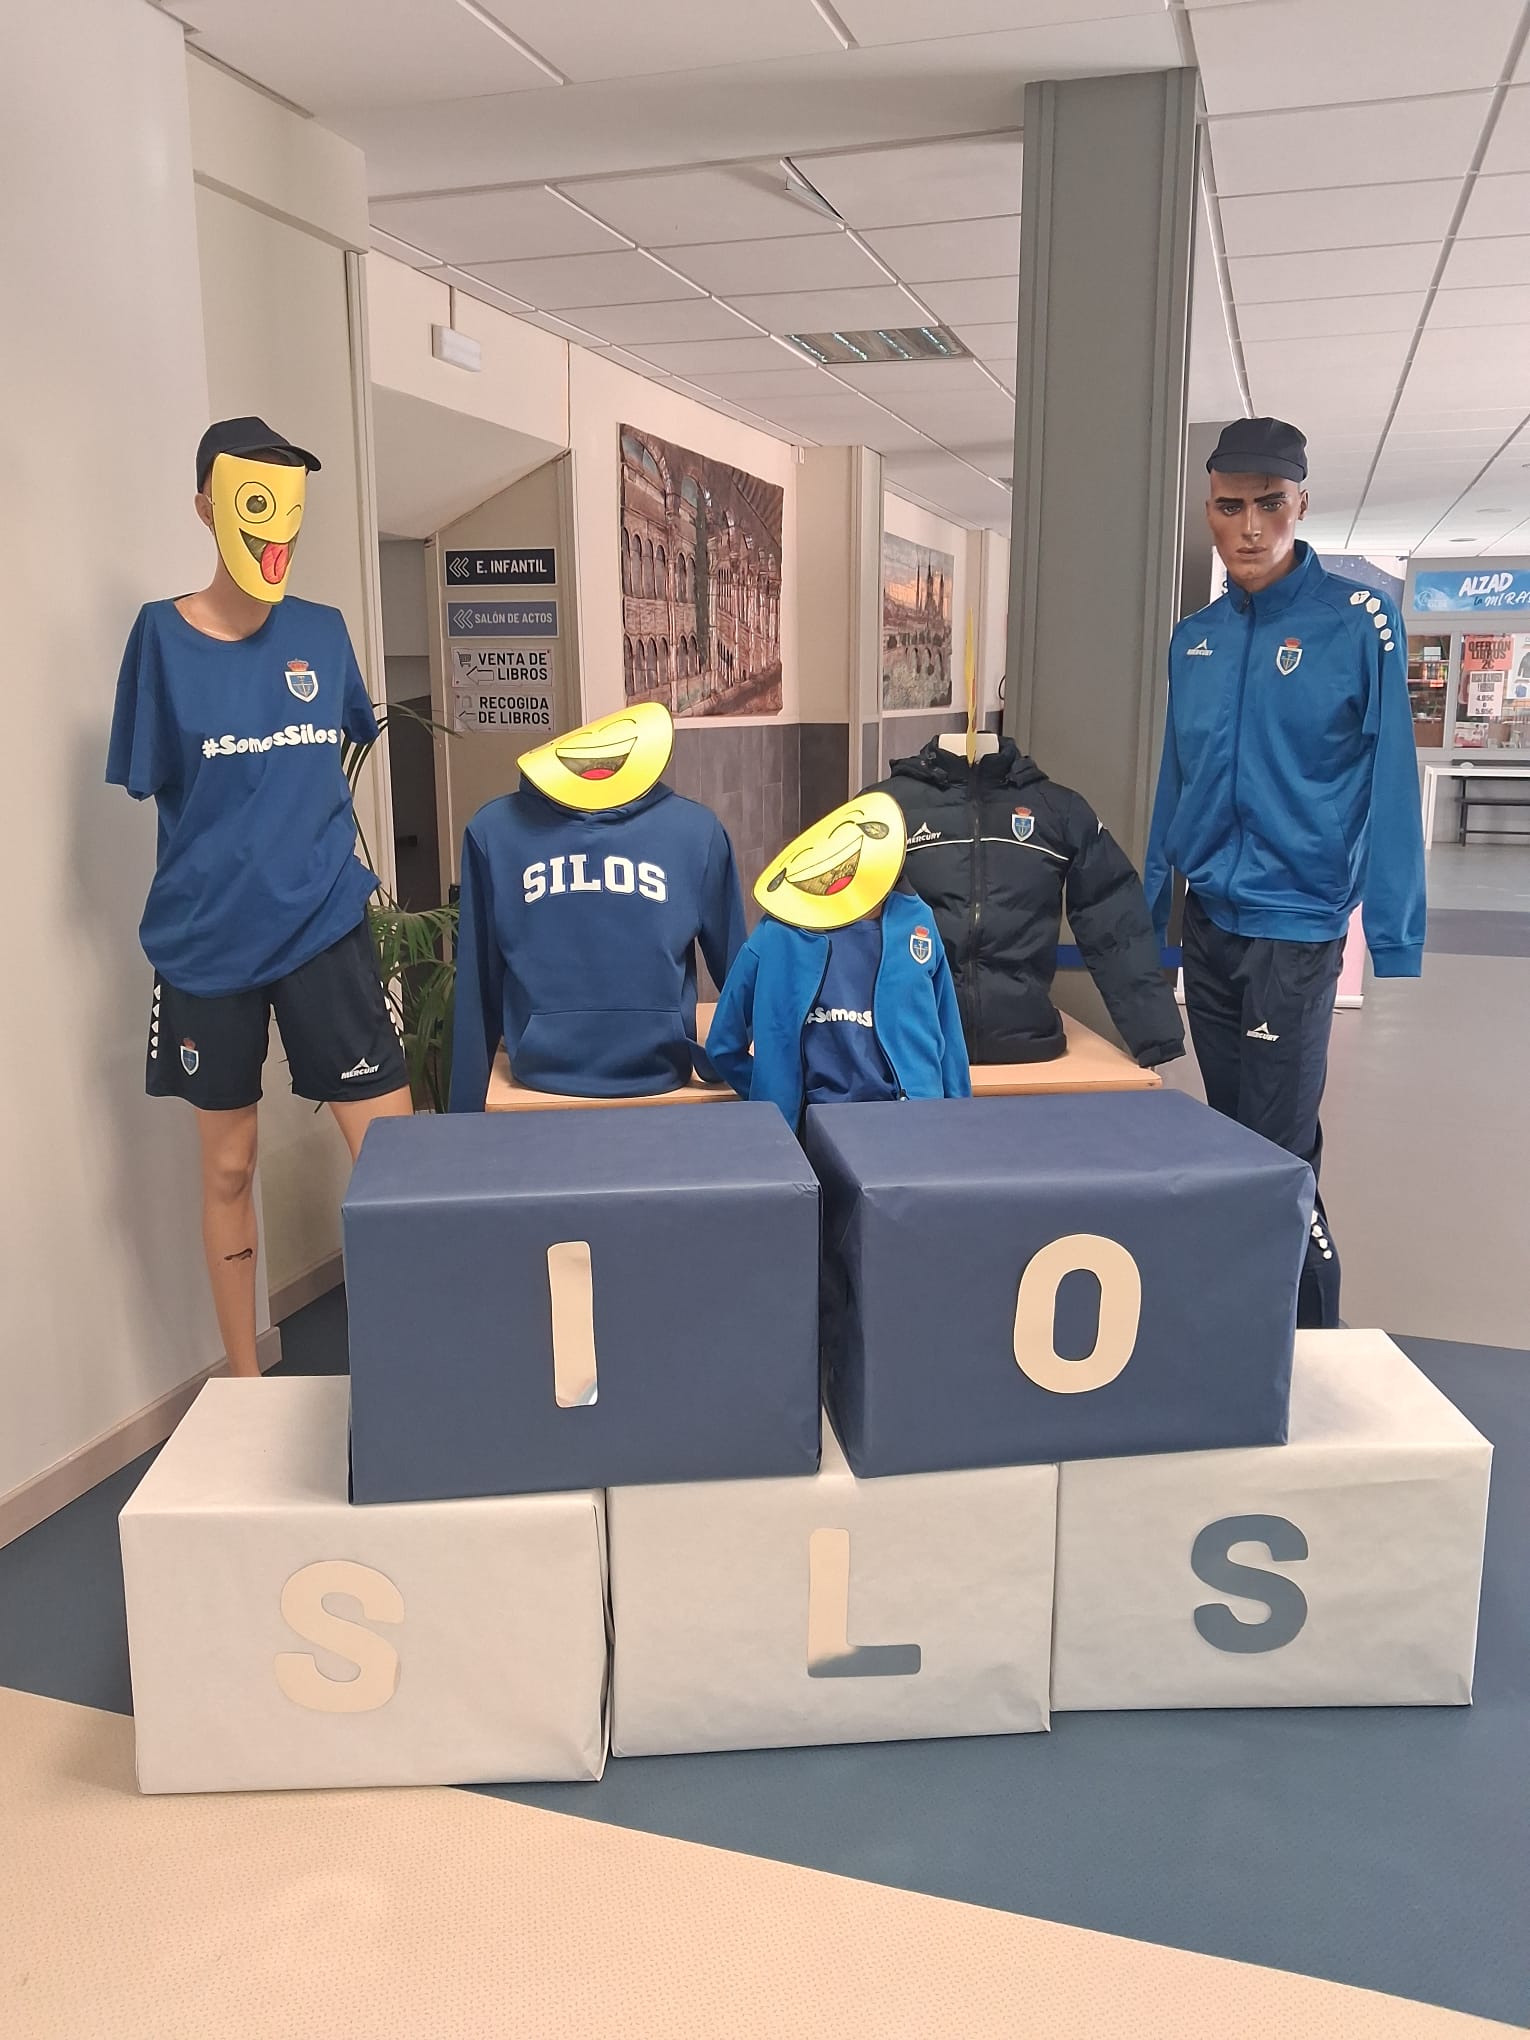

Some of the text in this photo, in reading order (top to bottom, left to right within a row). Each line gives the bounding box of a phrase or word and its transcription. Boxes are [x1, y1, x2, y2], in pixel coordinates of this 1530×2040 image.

[476, 559, 547, 574] E. INFANTIL
[1458, 572, 1514, 597] ALZAD
[474, 611, 553, 624] SALÓN DE ACTOS
[478, 652, 548, 666] VENTA DE
[497, 667, 548, 681] LIBROS
[479, 696, 549, 710] RECOGIDA
[478, 711, 550, 725] DE LIBROS
[201, 723, 338, 759] #SomosSilos
[522, 853, 669, 903] SILOS
[340, 1063, 380, 1080] MERCURY
[546, 1240, 598, 1408] I
[1013, 1233, 1142, 1394] O
[1190, 1513, 1310, 1654] S
[807, 1528, 922, 1678] L
[274, 1560, 406, 1713] S
